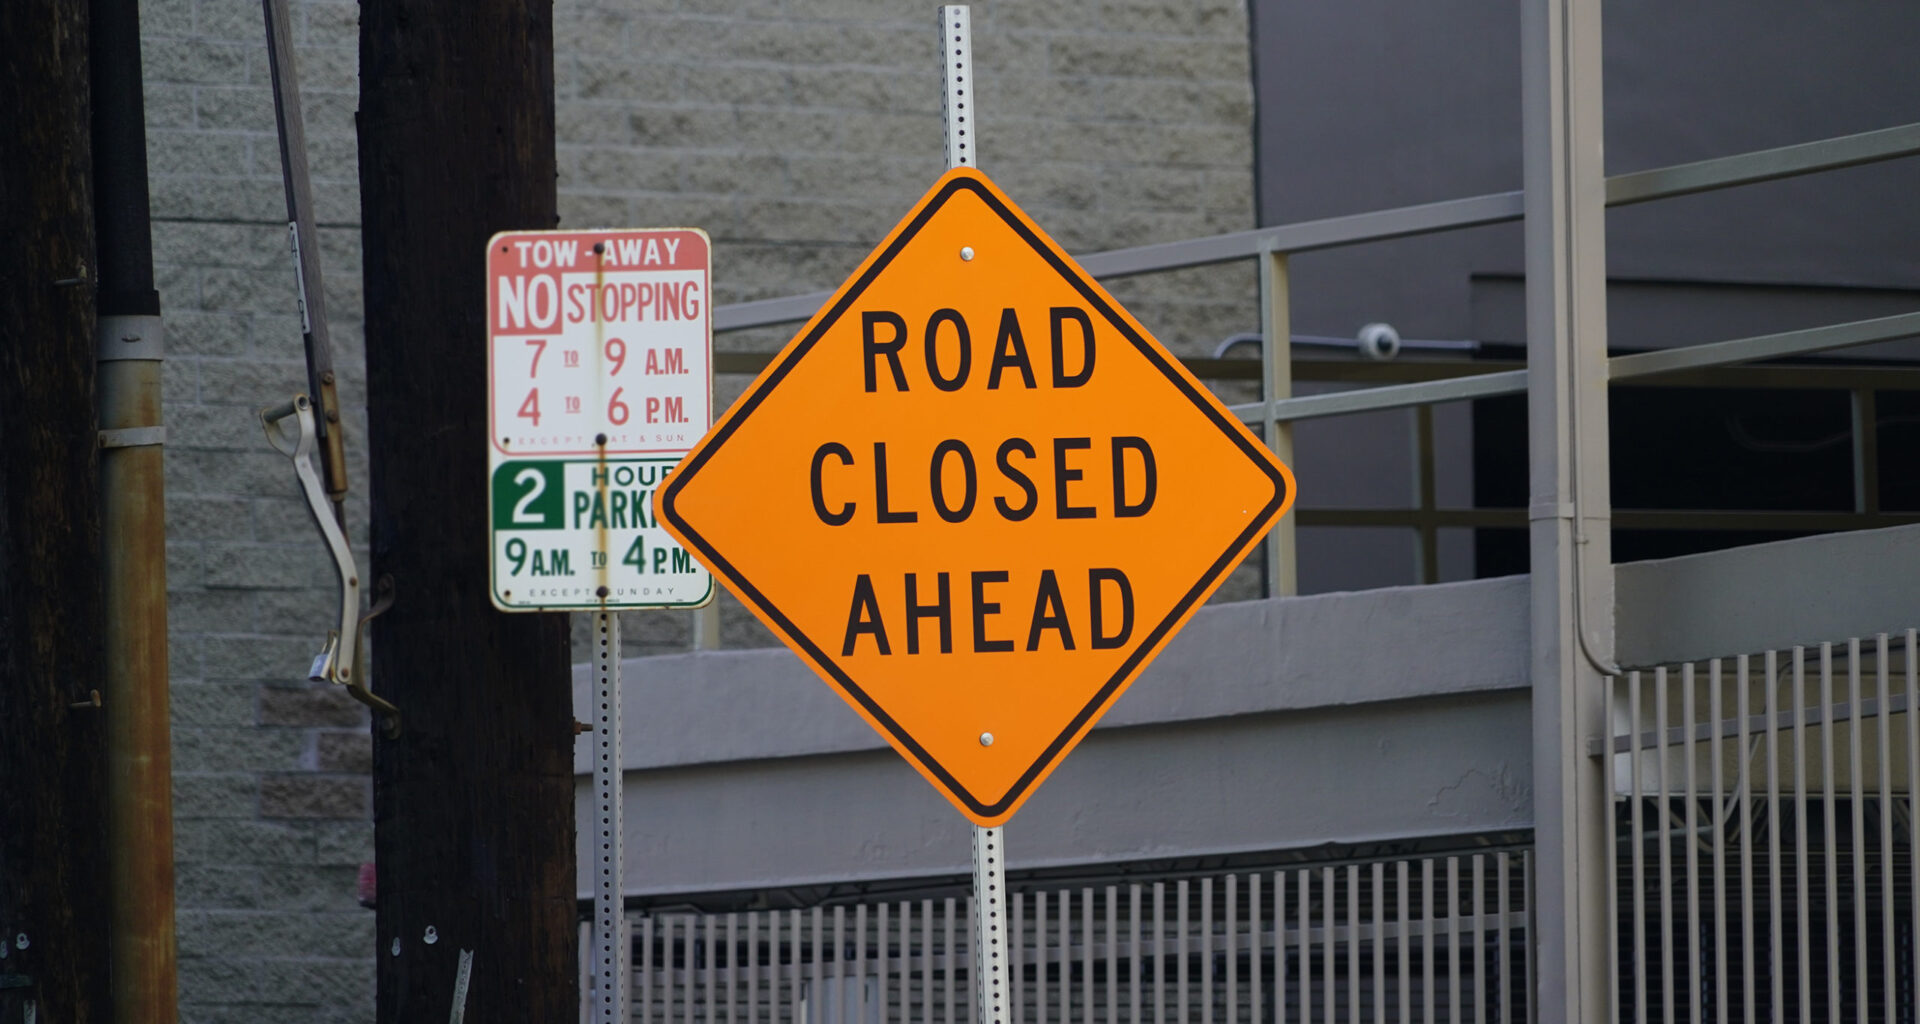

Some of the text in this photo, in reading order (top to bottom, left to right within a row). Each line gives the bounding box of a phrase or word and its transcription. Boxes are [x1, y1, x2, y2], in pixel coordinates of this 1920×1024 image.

[499, 273, 699, 329] NO STOPPING
[525, 337, 689, 378] 7 TO 9 A.M.
[861, 306, 1097, 393] ROAD
[517, 387, 541, 426] 4
[565, 396, 581, 413] TO
[608, 386, 630, 426] 6
[518, 436, 583, 446] EXCEPT
[512, 468, 547, 523] 2
[810, 436, 1158, 526] CLOSED
[505, 537, 528, 577] 9
[531, 549, 575, 577] A.M.
[591, 551, 607, 570] TO
[622, 534, 646, 575] 4
[529, 588, 591, 597] EXCEPT
[841, 567, 1135, 657] AHEAD
